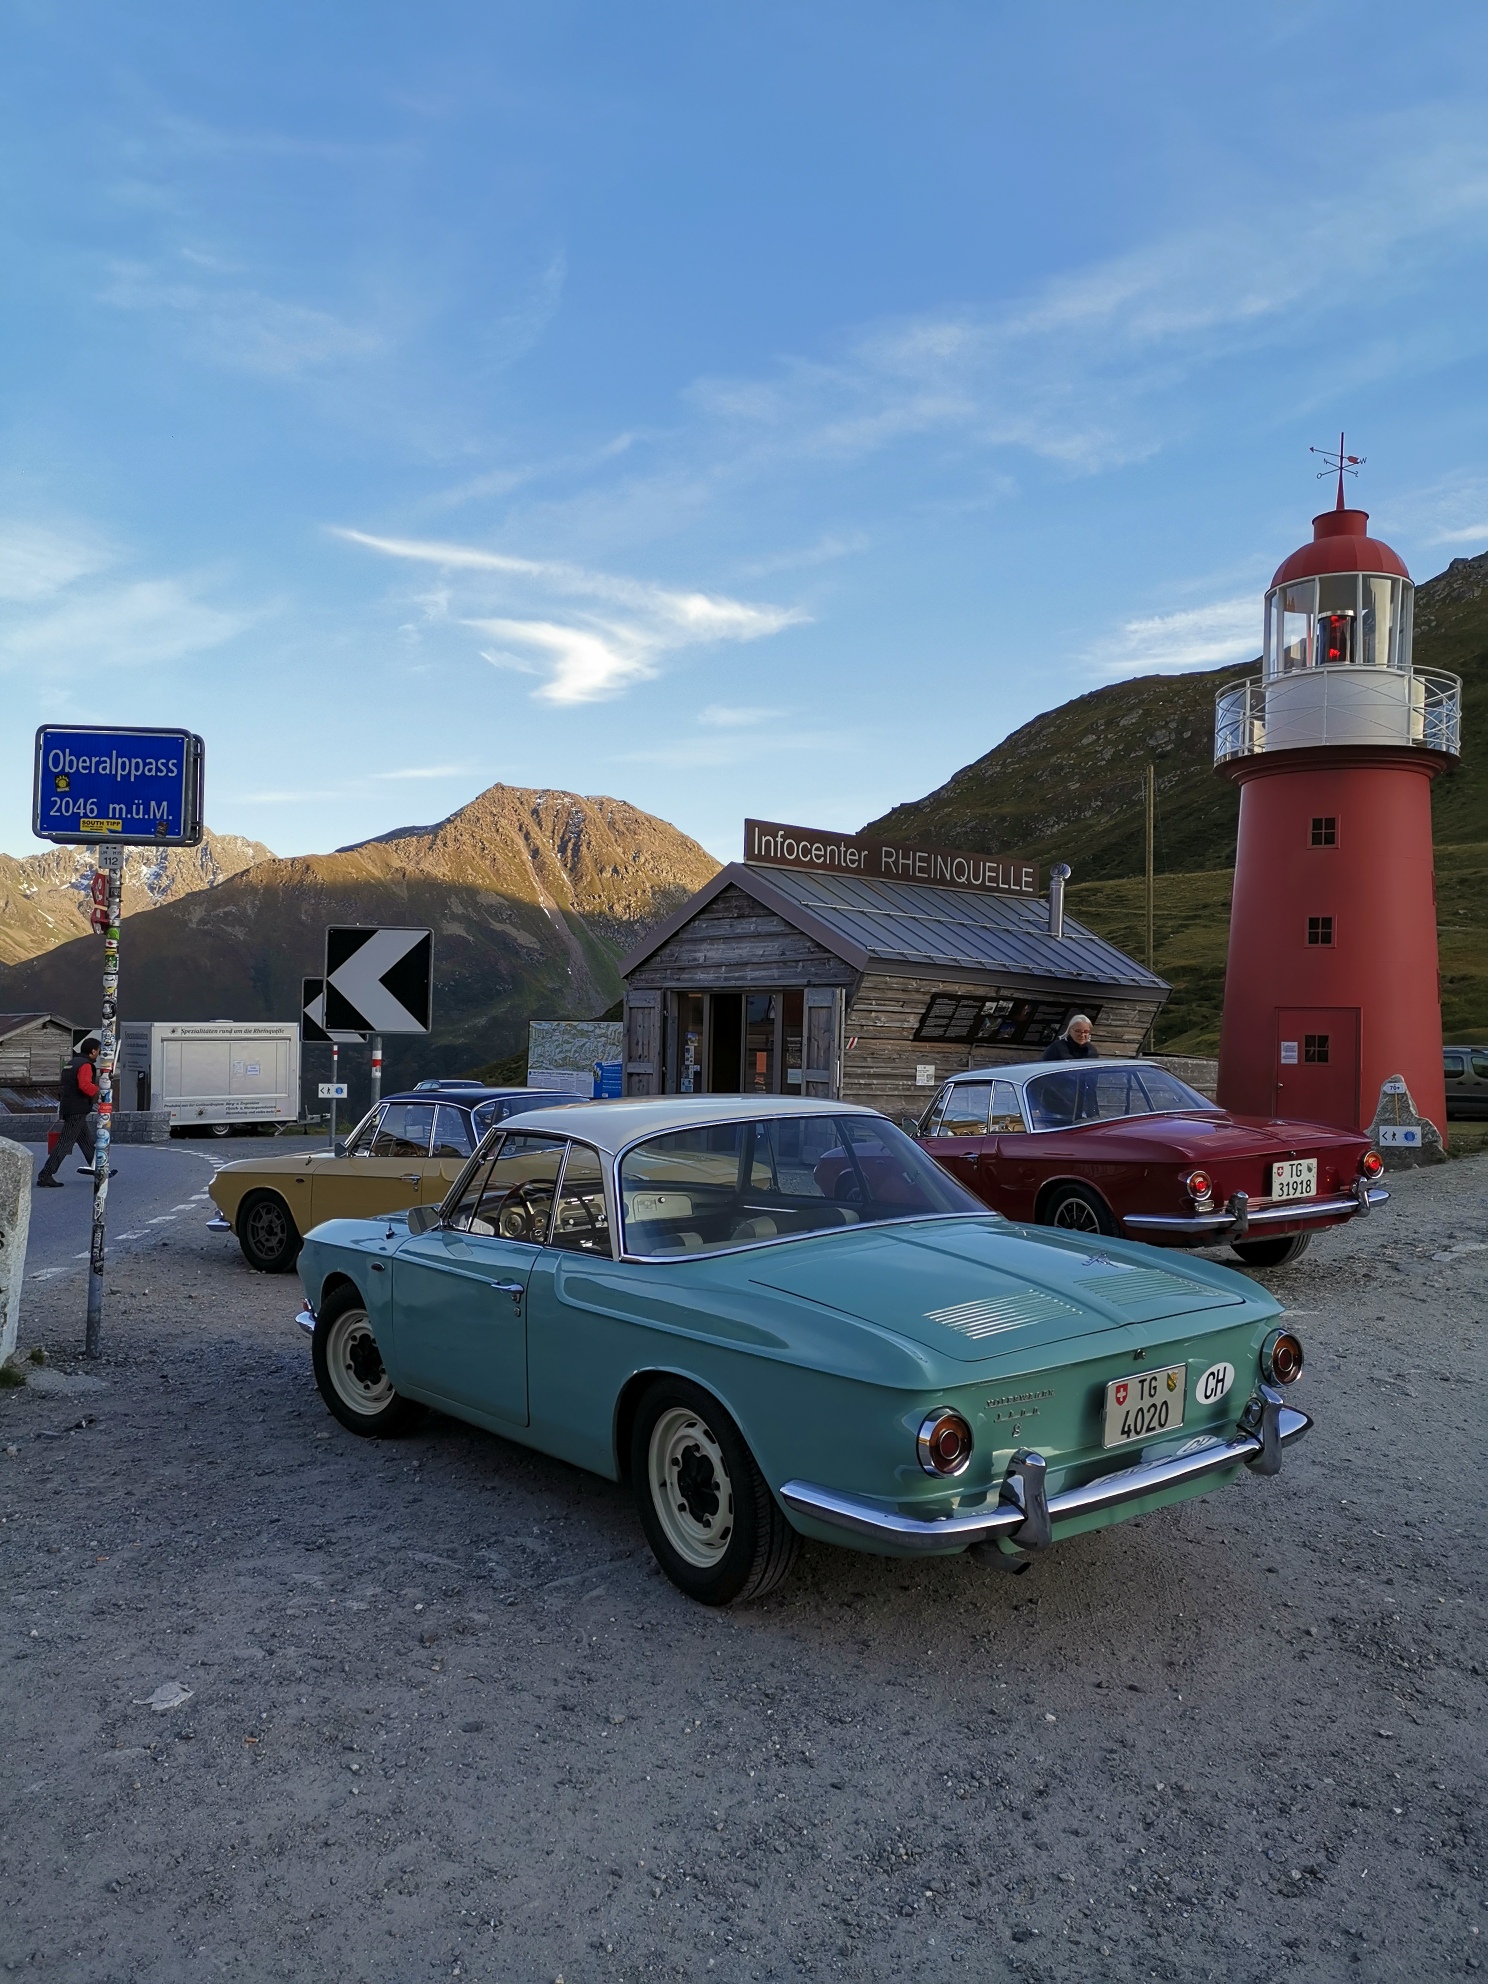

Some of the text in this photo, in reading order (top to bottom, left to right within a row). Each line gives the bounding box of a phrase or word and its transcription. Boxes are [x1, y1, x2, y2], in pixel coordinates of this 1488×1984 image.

[48, 749, 178, 781] Oberalppass
[50, 797, 173, 820] 2046 m.ü.M.
[103, 856, 119, 866] 112
[754, 826, 1035, 892] Infocenter RHEINQUELLE
[1289, 1162, 1303, 1178] TG
[1277, 1179, 1313, 1198] 31918
[1137, 1374, 1159, 1399] TG
[1203, 1366, 1227, 1399] CH
[1120, 1400, 1170, 1439] 4020
